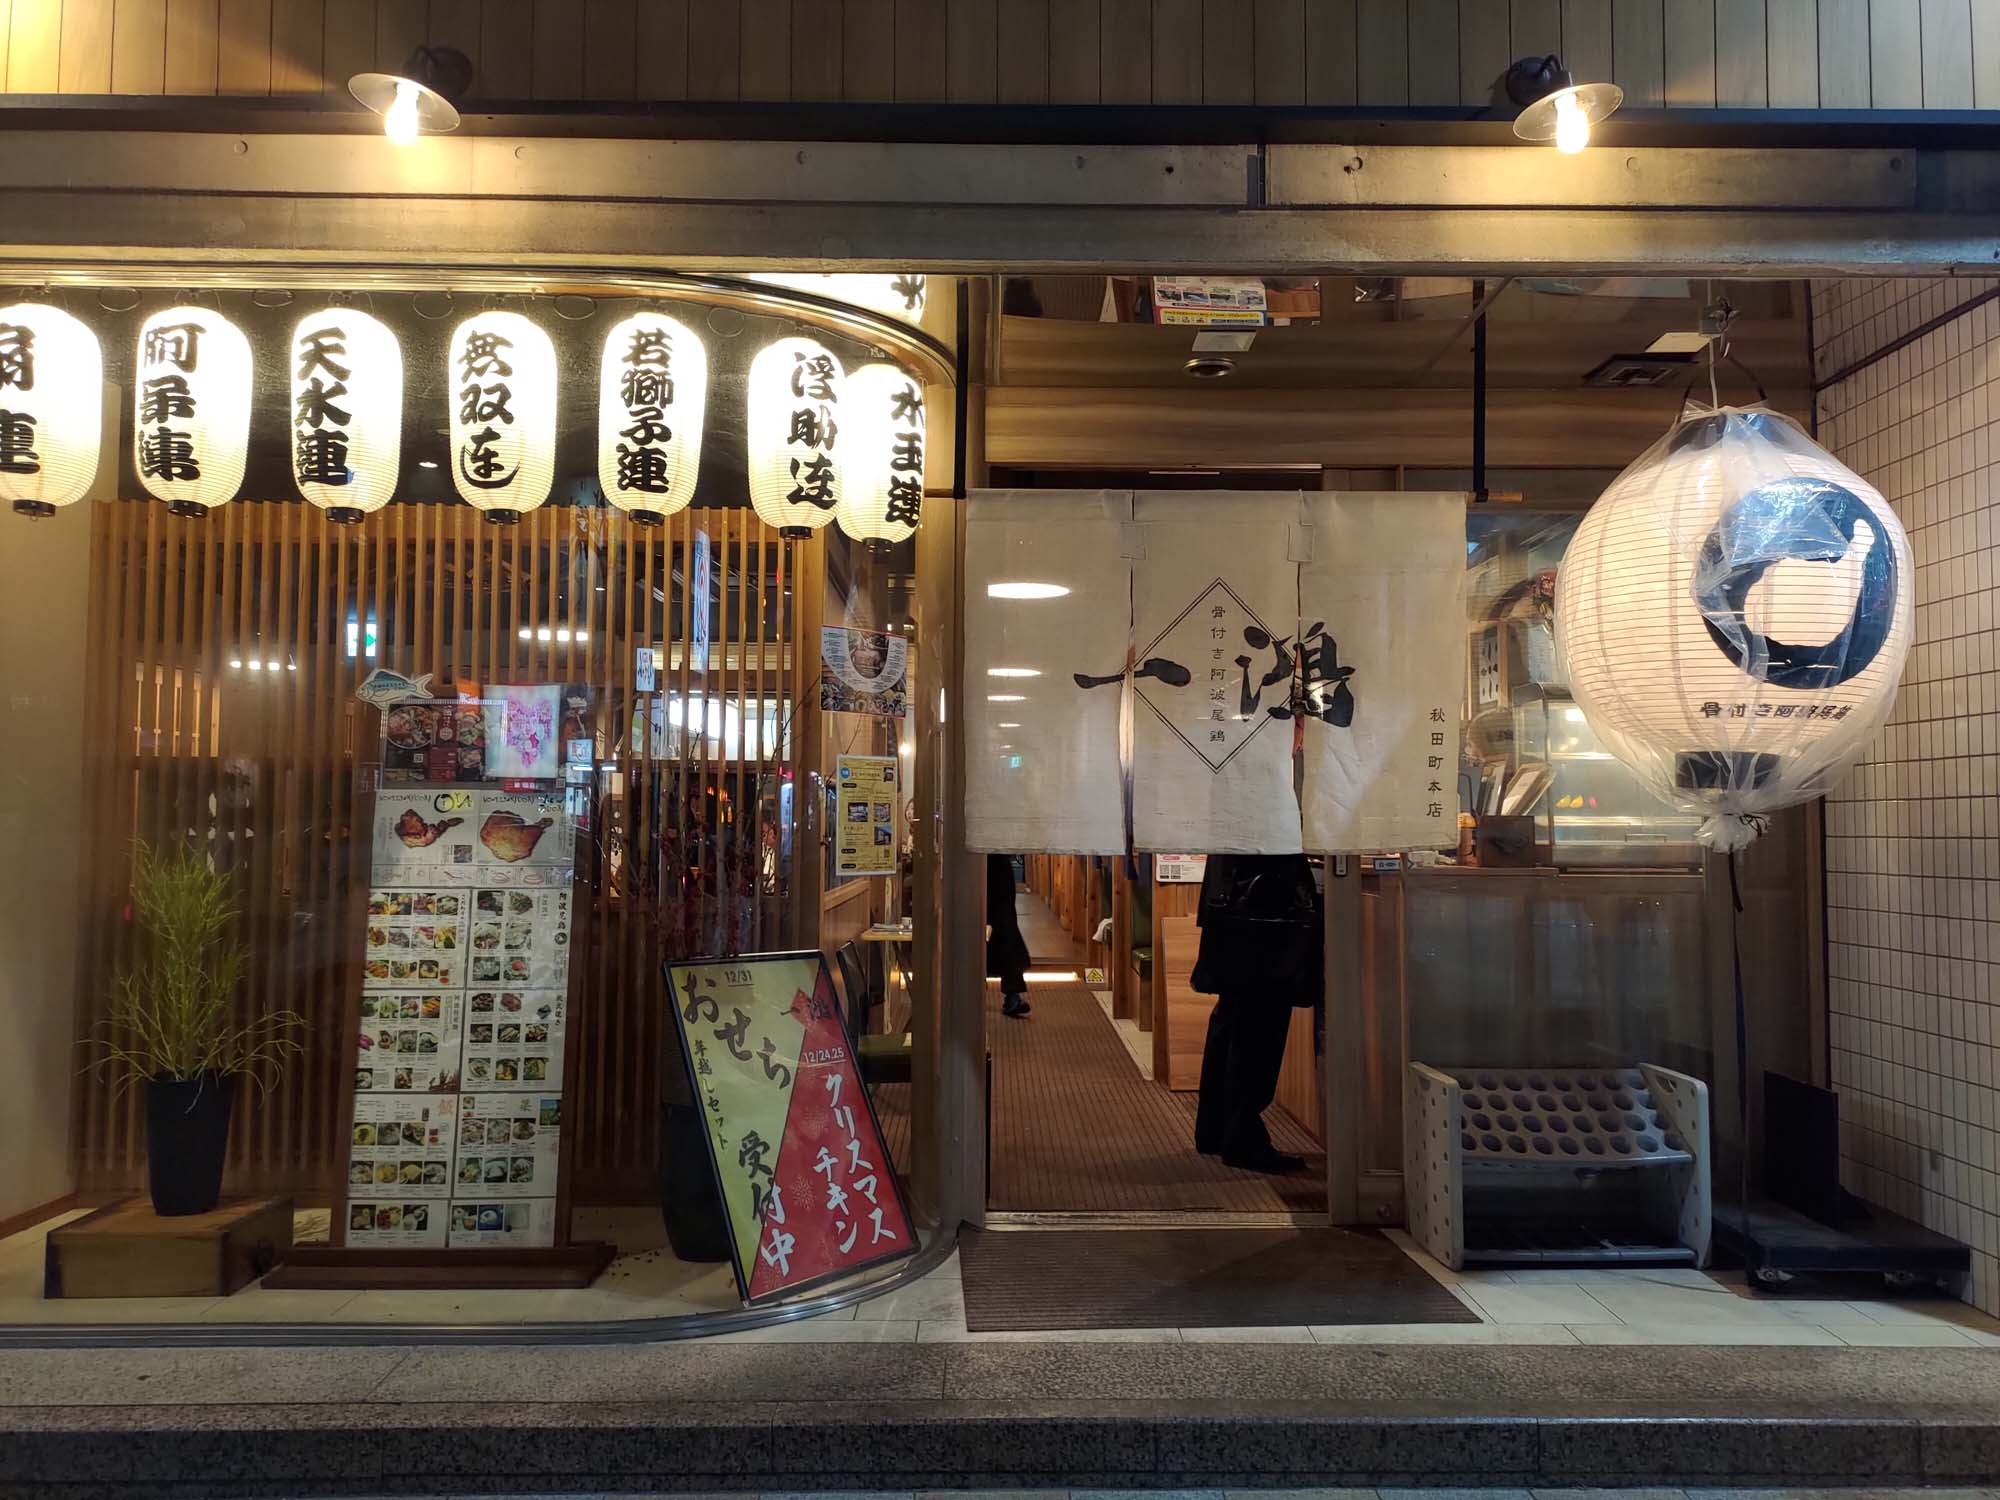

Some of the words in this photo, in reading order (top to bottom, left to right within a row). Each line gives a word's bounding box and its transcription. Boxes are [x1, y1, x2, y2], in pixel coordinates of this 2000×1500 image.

[296, 326, 353, 488] 天水連
[616, 328, 674, 493] 若獅子連
[885, 382, 926, 529] 水玉連
[1426, 707, 1446, 818] 秋田町本店
[681, 970, 791, 1090] おせち
[724, 970, 753, 983] 12/31
[694, 1039, 728, 1151] 年越しセット
[804, 1047, 845, 1064] 12/24.25
[738, 1129, 797, 1278] 受付中
[812, 1146, 858, 1255] チキン
[824, 1072, 898, 1245] クリスマス
